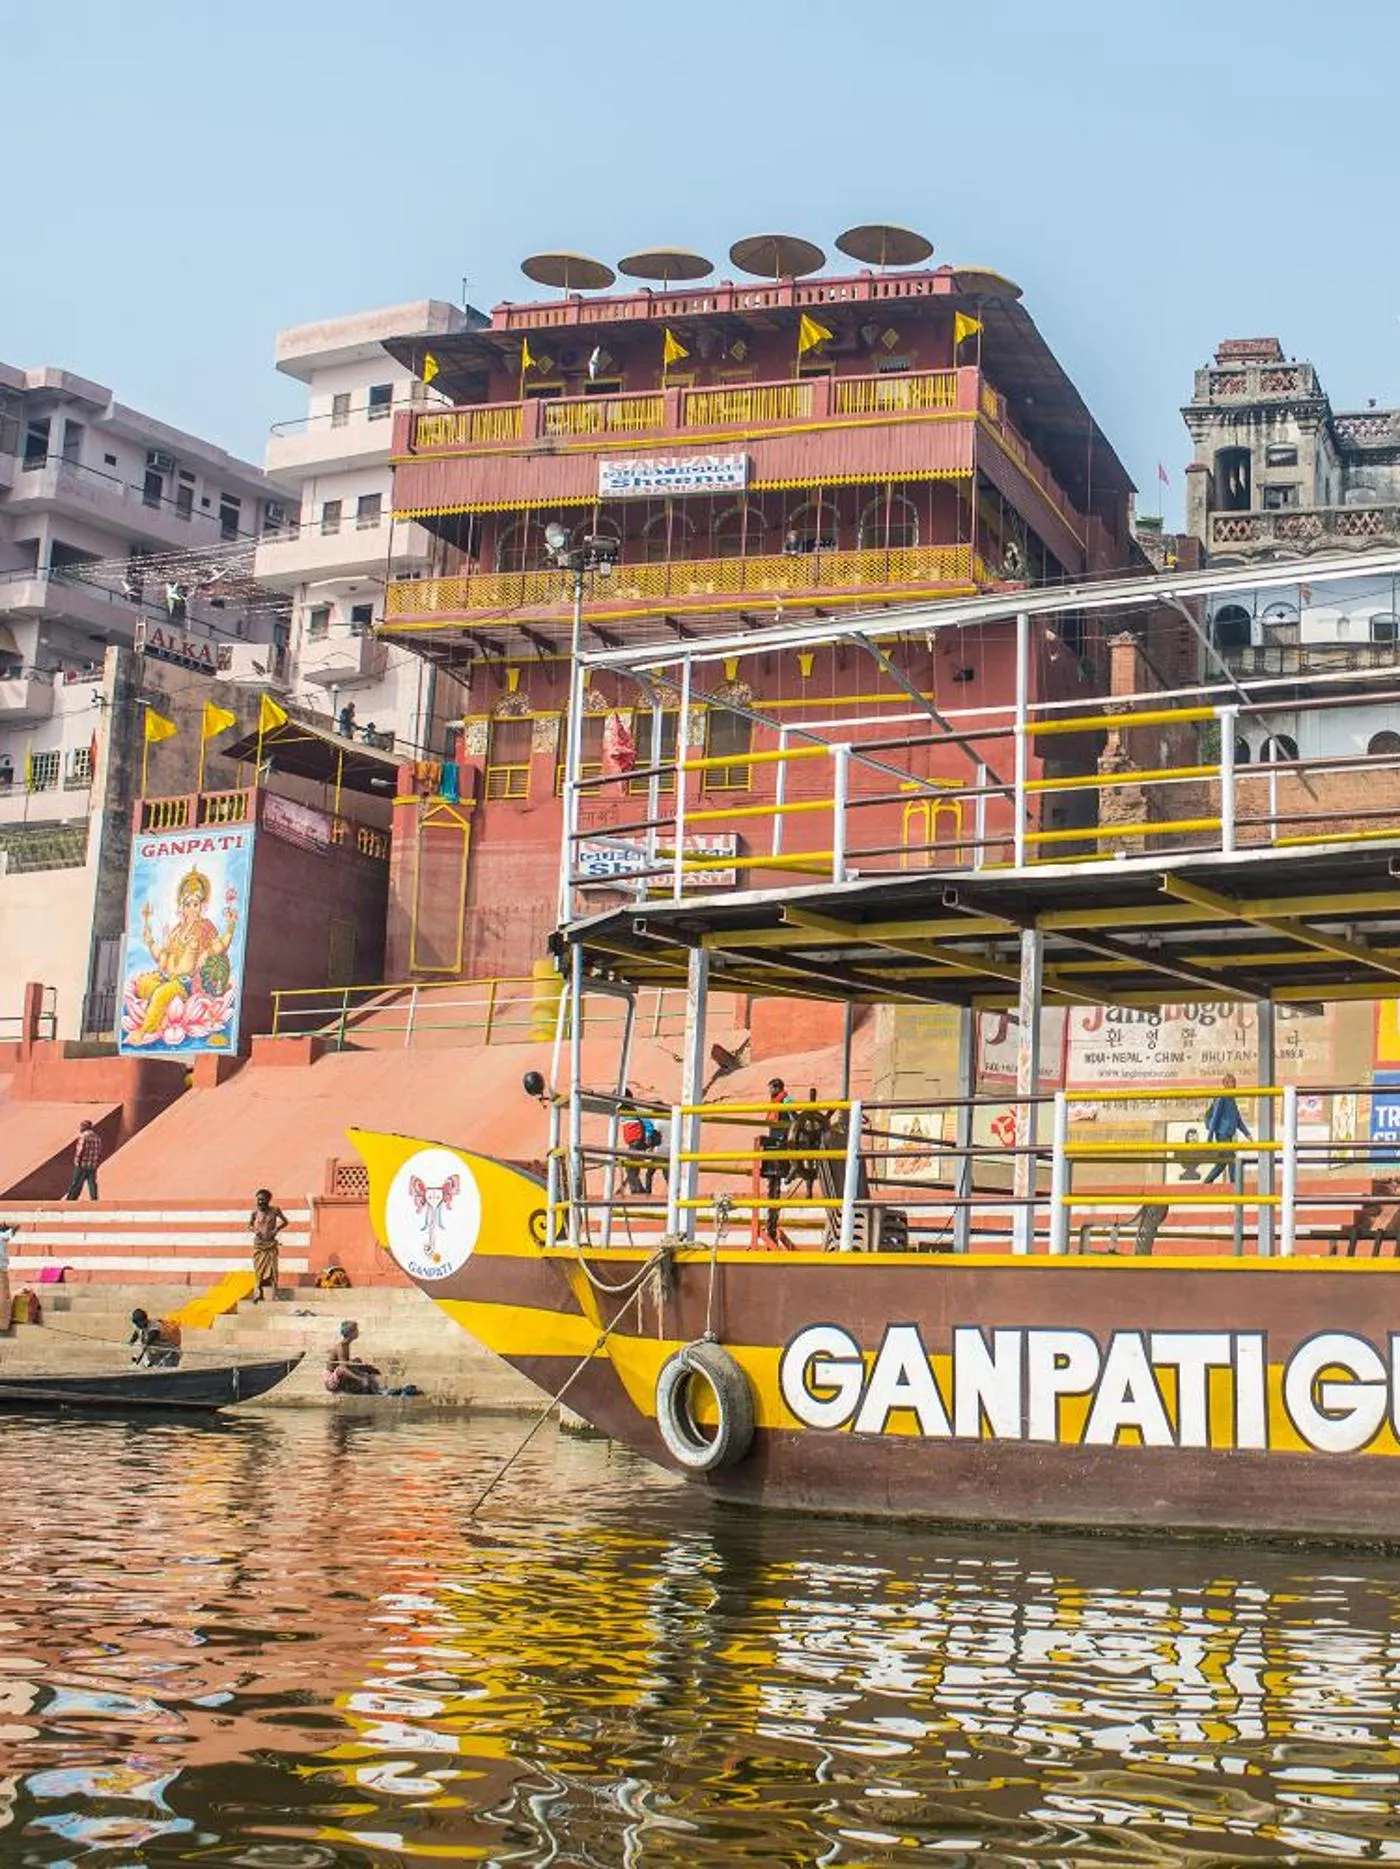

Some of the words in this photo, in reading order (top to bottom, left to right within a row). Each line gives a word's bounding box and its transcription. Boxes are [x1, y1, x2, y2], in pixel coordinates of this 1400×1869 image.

[141, 835, 243, 858] GANPATI
[1111, 1051, 1143, 1063] NEPAL
[1201, 1050, 1251, 1064] BHUTAN
[408, 1260, 454, 1277] GANPATI
[778, 1321, 1269, 1452] GANPATI
